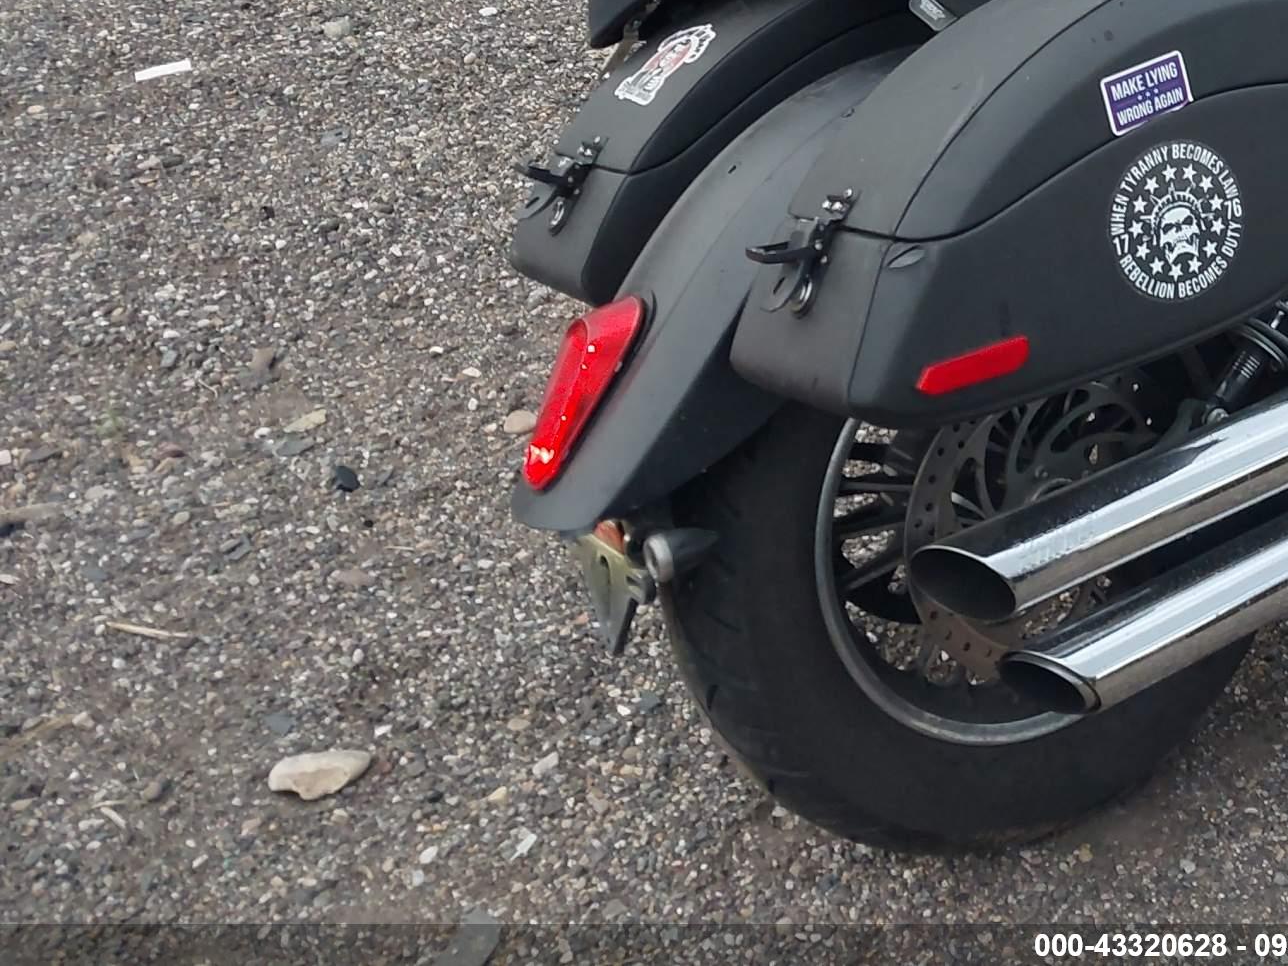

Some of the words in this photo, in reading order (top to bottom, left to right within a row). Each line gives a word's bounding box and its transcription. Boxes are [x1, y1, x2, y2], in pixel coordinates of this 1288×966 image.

[1111, 75, 1146, 102] MAKE
[1145, 61, 1179, 89] LYING
[1116, 98, 1155, 127] WRONG
[1154, 87, 1184, 113] AGAIN
[1110, 191, 1128, 237] WHEN
[1121, 145, 1169, 194] TYRANNY
[1171, 143, 1224, 176] BECOMES
[1218, 170, 1240, 200] LAW
[1224, 199, 1242, 218] 76
[1113, 234, 1131, 256] 17
[1119, 252, 1175, 300] REBELLION
[1177, 256, 1229, 298] BECOMES
[1223, 221, 1243, 259] DUTY
